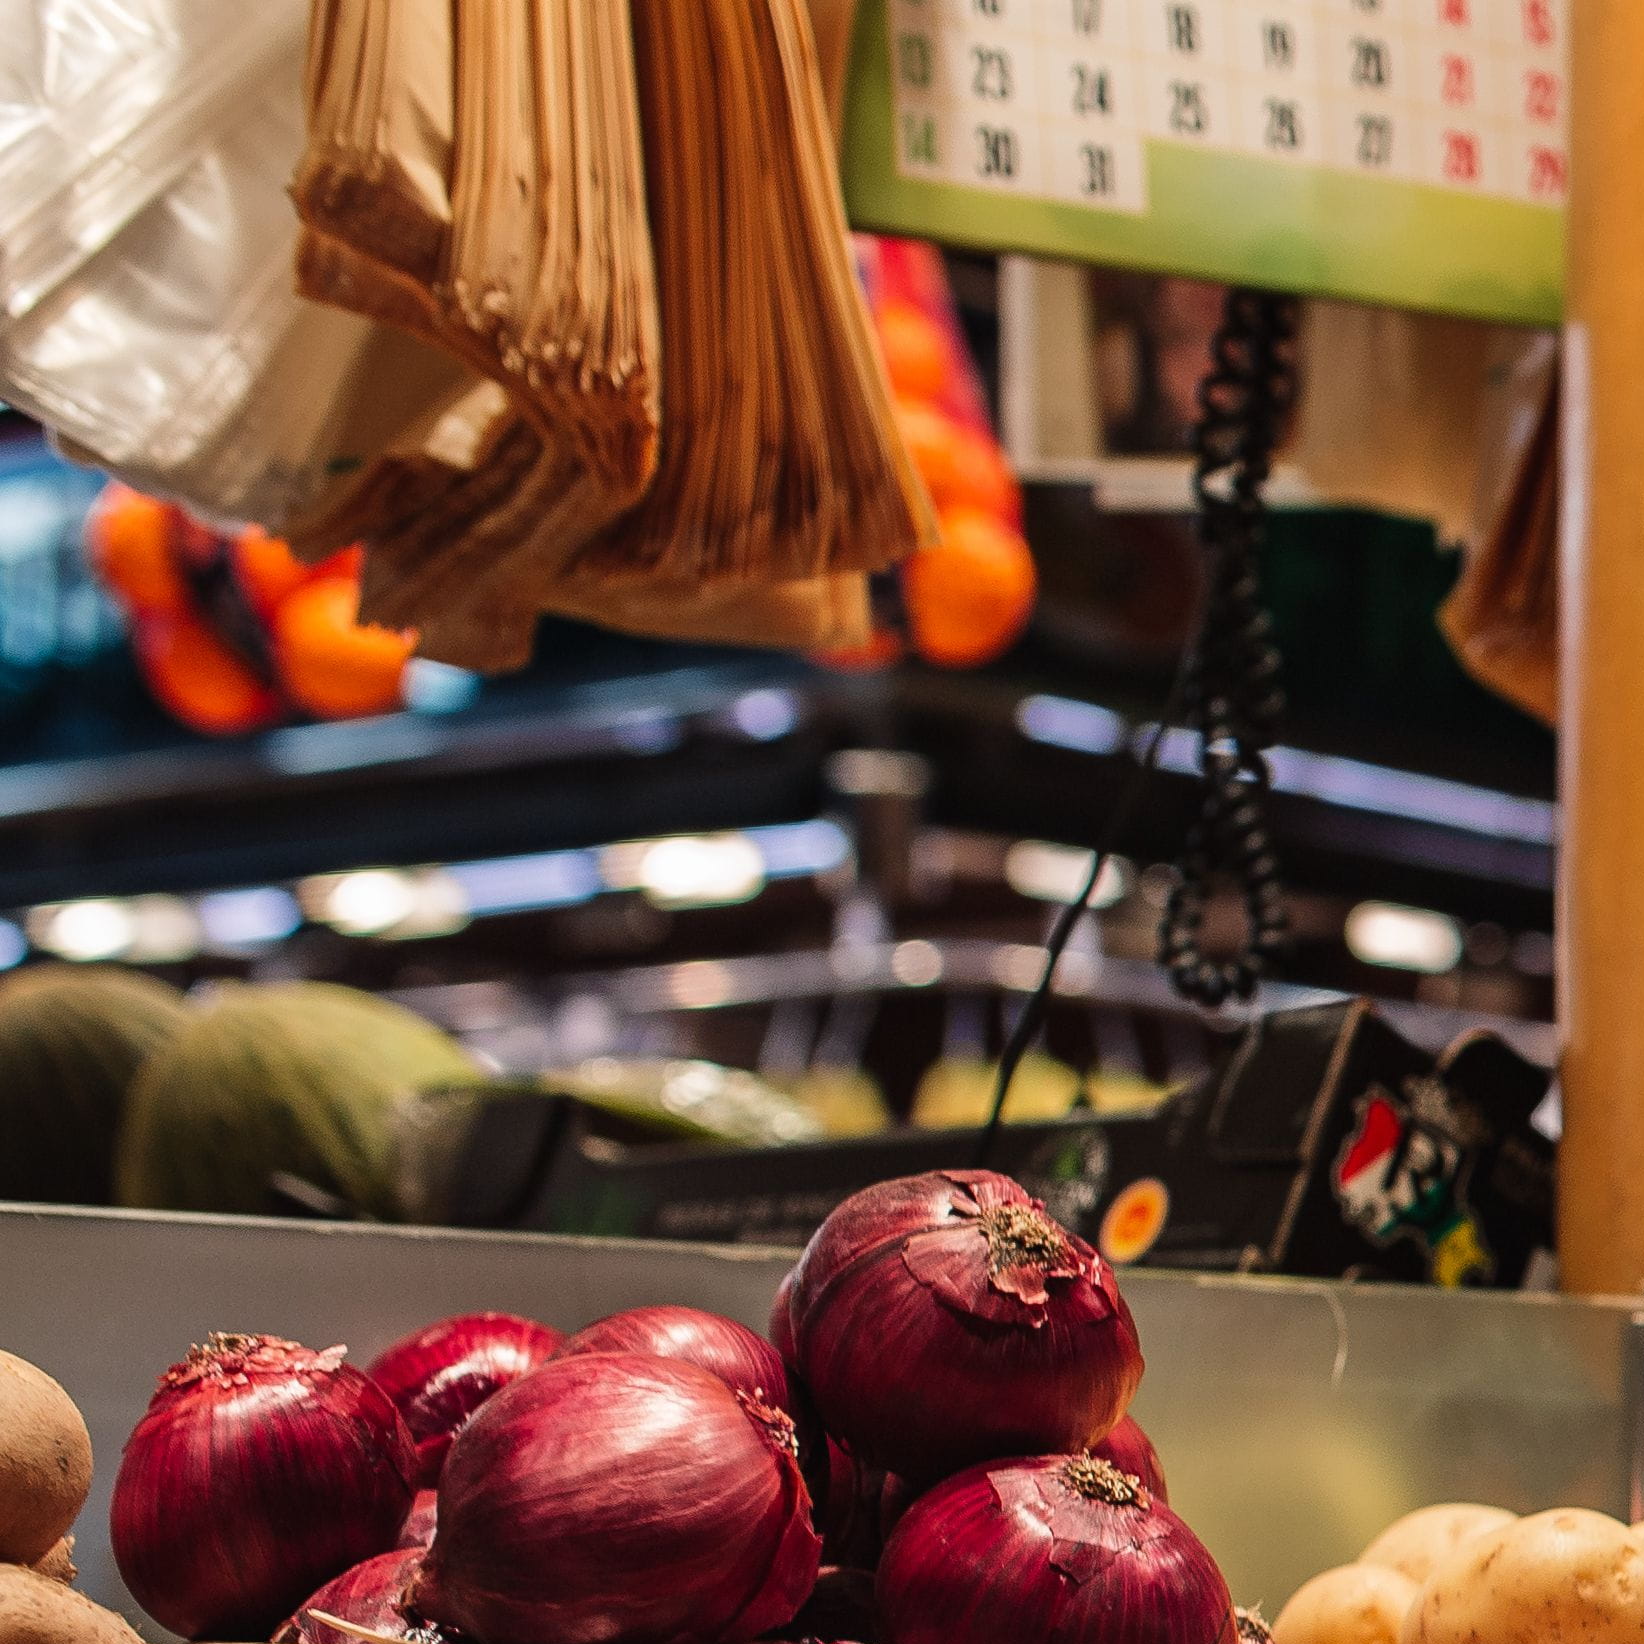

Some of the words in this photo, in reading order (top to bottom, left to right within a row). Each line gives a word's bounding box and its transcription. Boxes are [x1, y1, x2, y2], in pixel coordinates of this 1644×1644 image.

[1167, 3, 1202, 53] 18
[1262, 20, 1296, 70] 19
[1350, 35, 1393, 88] 20
[972, 44, 1014, 99] 23
[1073, 61, 1112, 115] 24
[1170, 79, 1210, 134] 25
[1265, 97, 1304, 150] 26
[1355, 112, 1393, 166] 27
[1442, 128, 1481, 184] 28
[976, 123, 1018, 178] 30
[1080, 139, 1115, 195] 31
